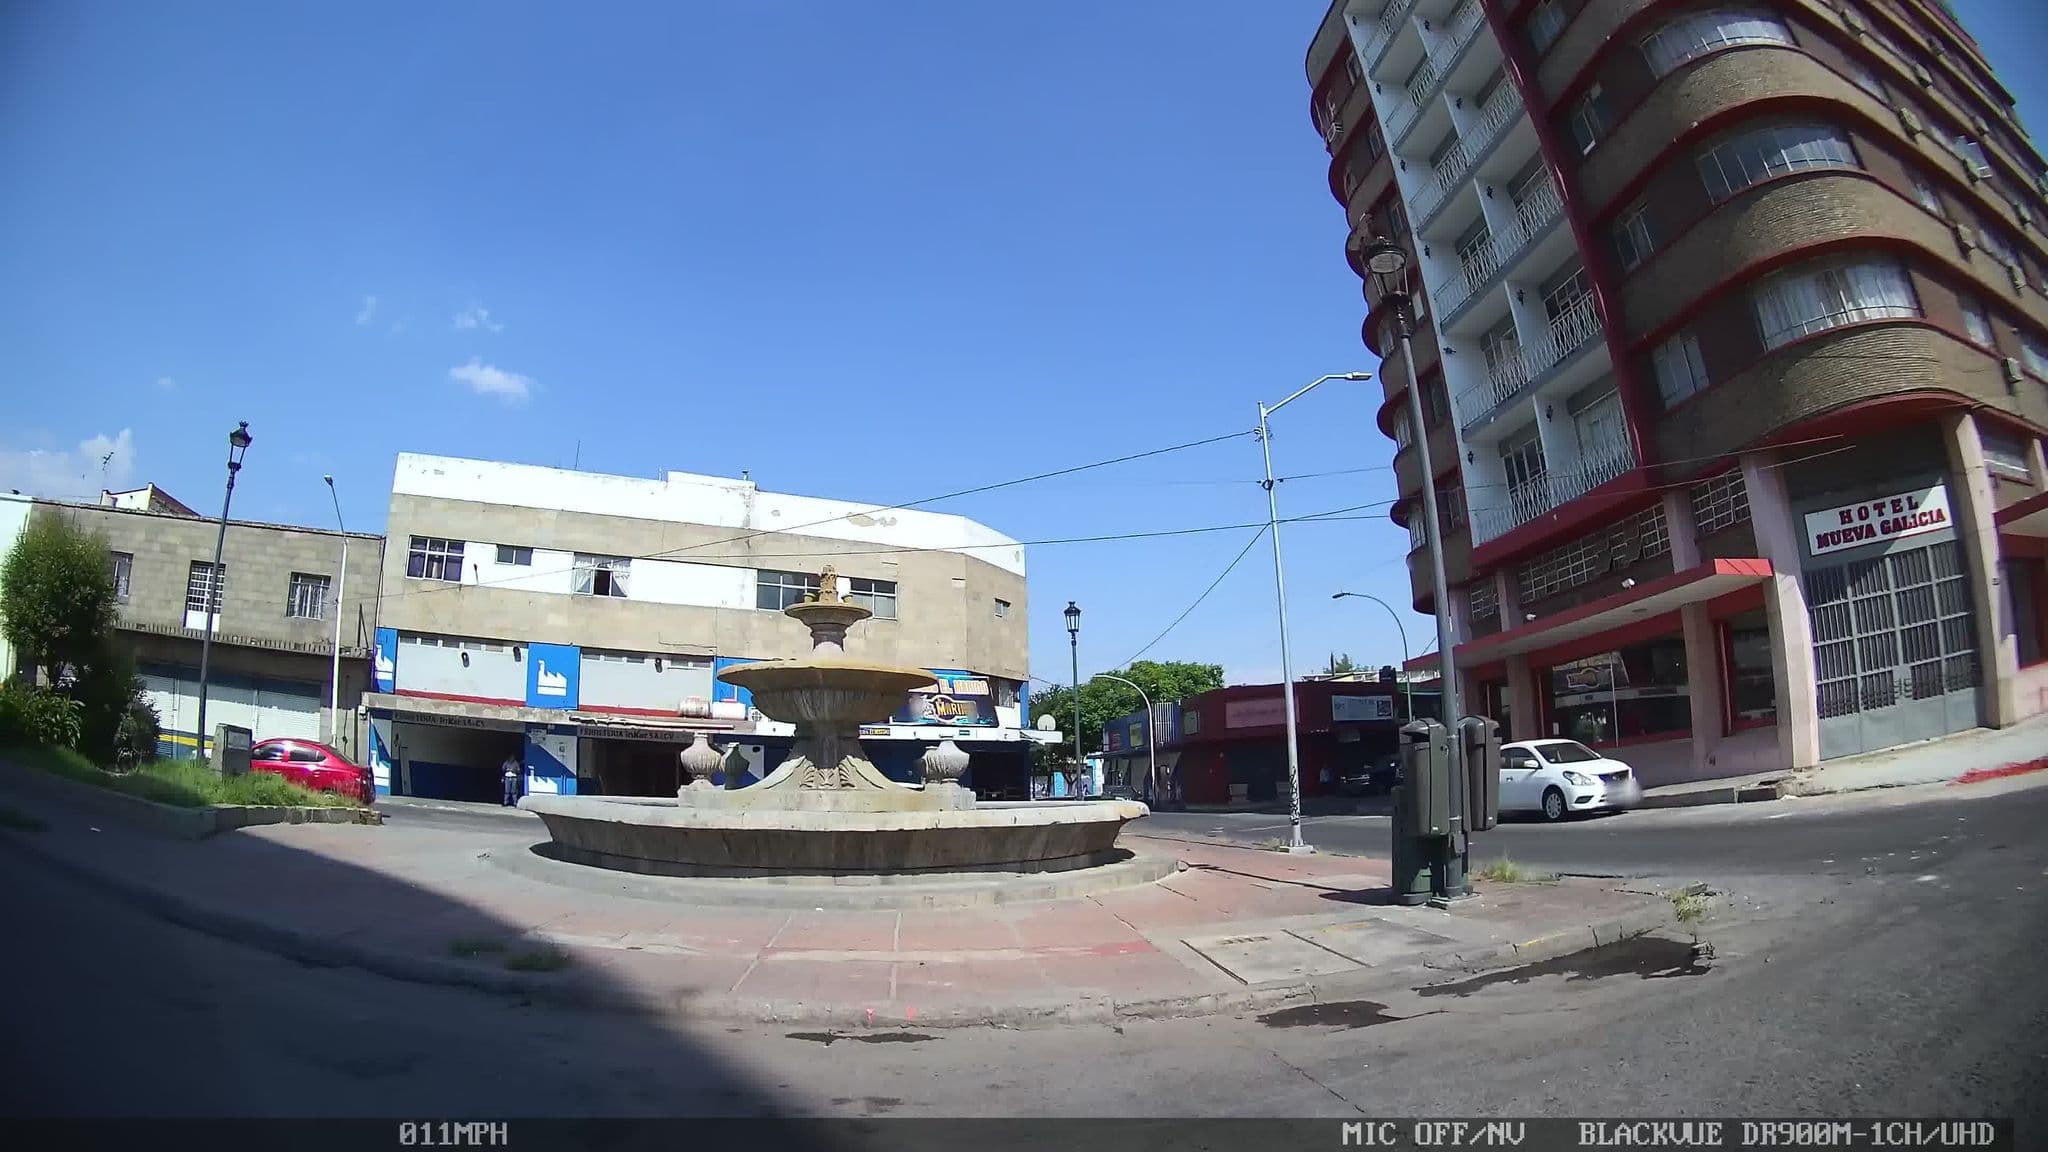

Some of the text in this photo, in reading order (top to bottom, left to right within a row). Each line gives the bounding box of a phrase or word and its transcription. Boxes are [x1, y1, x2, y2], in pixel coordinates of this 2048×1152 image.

[1839, 495, 1919, 525] HOTEL
[1815, 508, 1946, 549] NUEVA GALICIA
